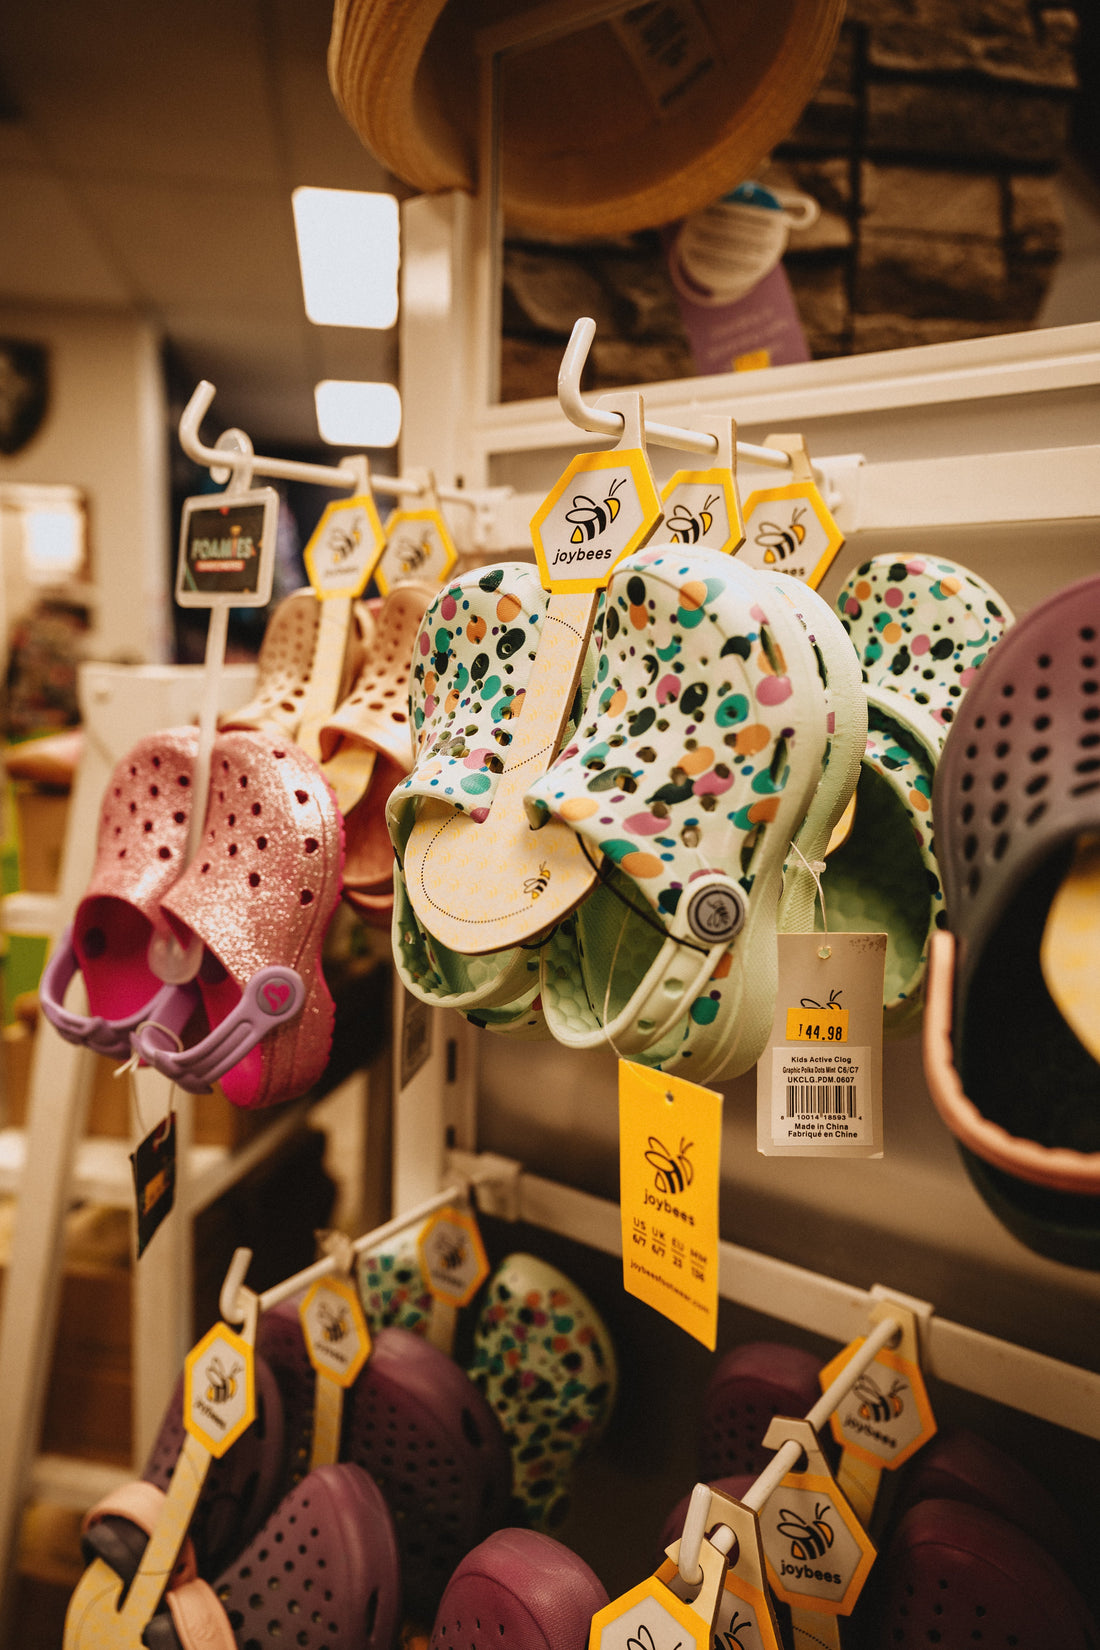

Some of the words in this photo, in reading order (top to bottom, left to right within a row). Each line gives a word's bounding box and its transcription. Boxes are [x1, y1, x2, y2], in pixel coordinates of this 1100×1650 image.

[552, 547, 613, 566] joybees
[834, 1056, 852, 1065] Clog
[782, 1066, 801, 1075] Graphic
[801, 1066, 814, 1074] Polka
[814, 1066, 826, 1074] Dots
[825, 1066, 837, 1074] Mint
[787, 1076, 855, 1084] UKCLG.PDM.0607
[787, 1130, 822, 1139] Fabriqué
[834, 1130, 858, 1138] Chine
[643, 1188, 695, 1227] joybees
[633, 1217, 646, 1231] US
[781, 1559, 842, 1585] joybees
